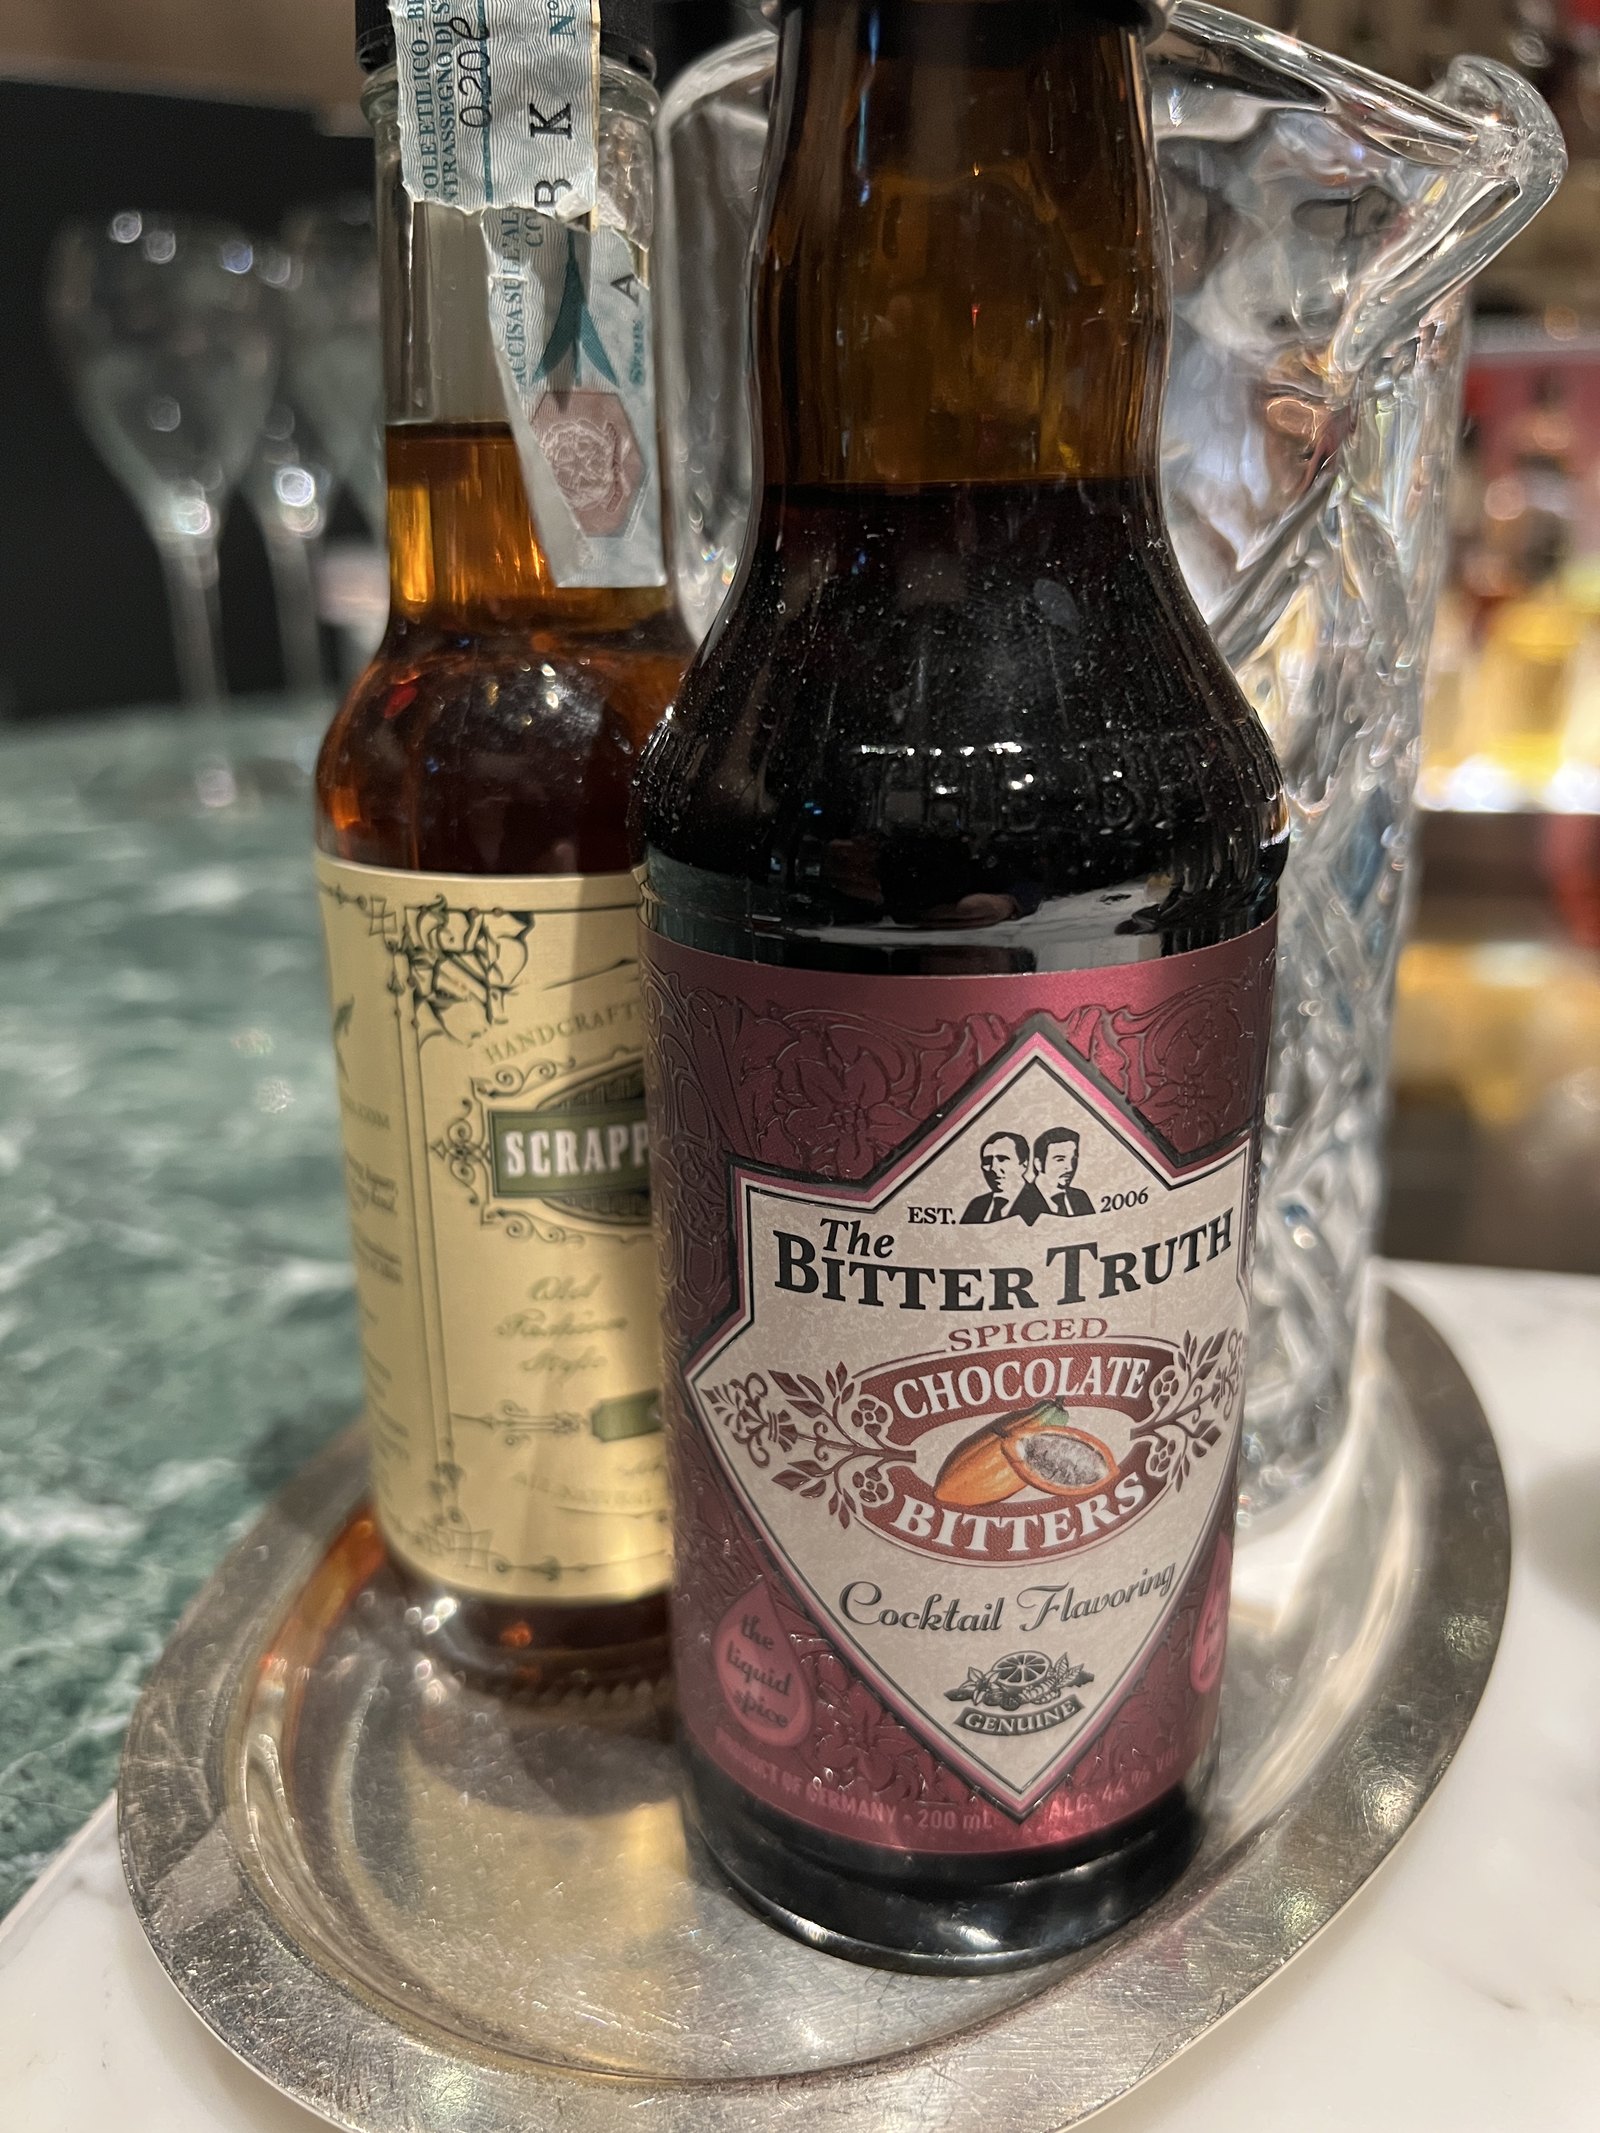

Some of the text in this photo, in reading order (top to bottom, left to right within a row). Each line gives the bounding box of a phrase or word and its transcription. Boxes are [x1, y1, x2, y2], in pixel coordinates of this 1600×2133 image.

[433, 21, 454, 44] DI
[411, 38, 437, 135] ETILICO
[529, 102, 573, 139] K
[907, 1187, 1149, 1225] EST. 2006
[819, 1217, 895, 1260] The
[772, 1206, 1234, 1312] BITTER TRUTH
[948, 1316, 1109, 1352] SPICED
[892, 1356, 1151, 1420] CHOCOLATE
[889, 1472, 1146, 1553] BITTERS
[838, 1580, 1006, 1633] Cocktail
[1016, 1561, 1177, 1633] Flavoring
[963, 1700, 1077, 1734] GENUINE
[917, 1808, 957, 1830] 200
